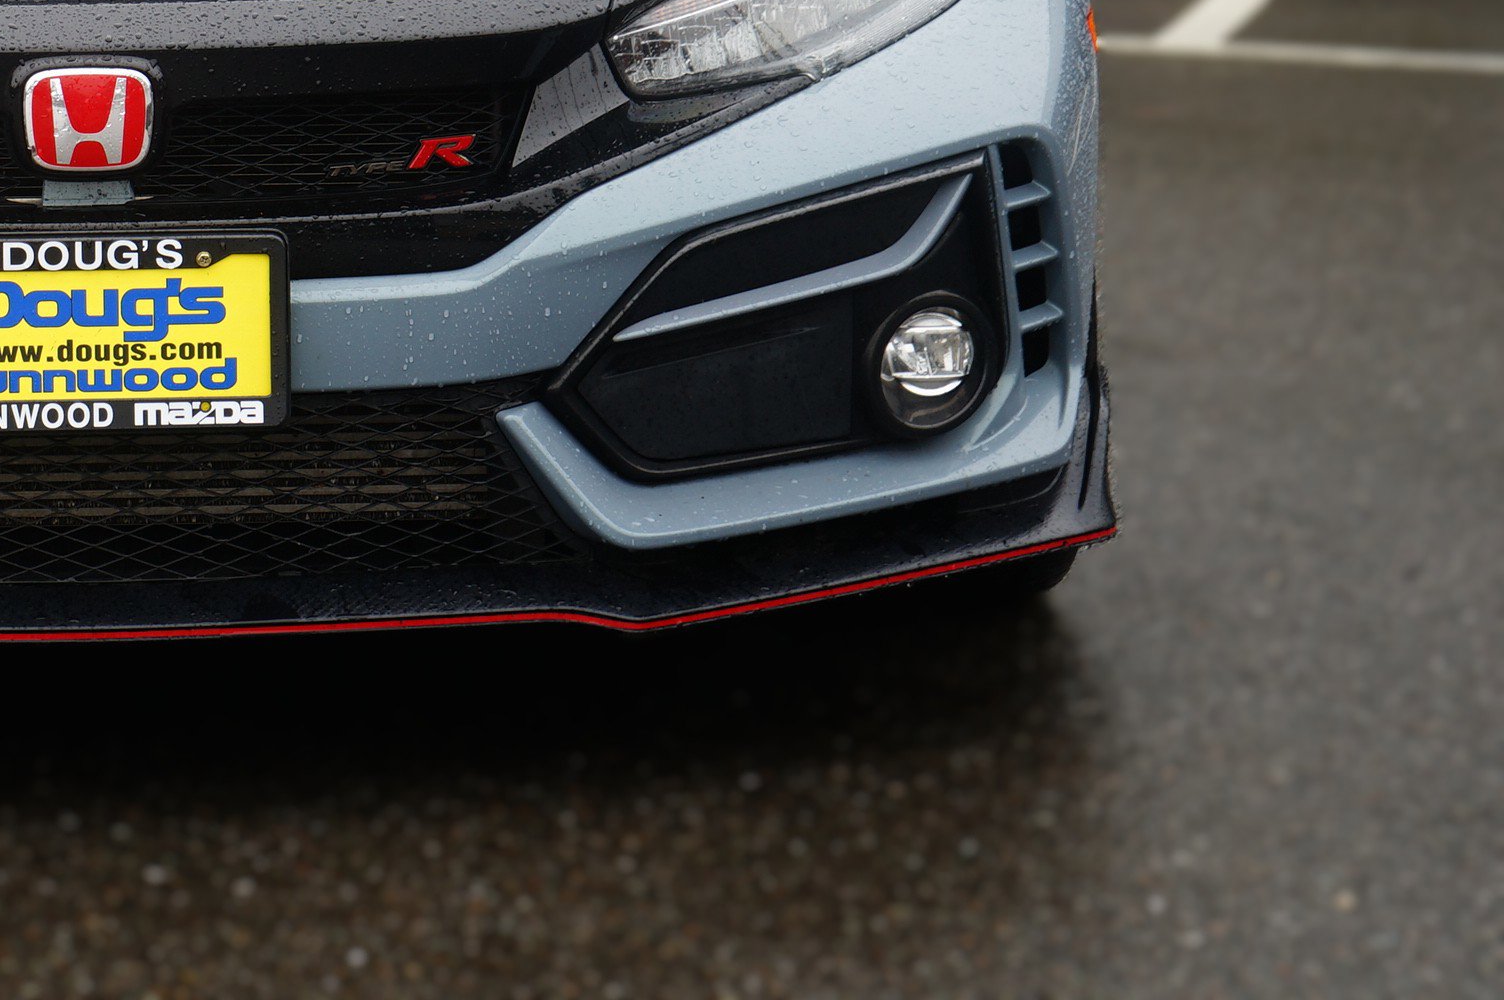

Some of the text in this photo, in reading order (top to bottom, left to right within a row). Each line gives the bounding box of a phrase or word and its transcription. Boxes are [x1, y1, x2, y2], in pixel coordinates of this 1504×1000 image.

[328, 133, 477, 177] TYPE R
[2, 238, 184, 272] DOUG'S
